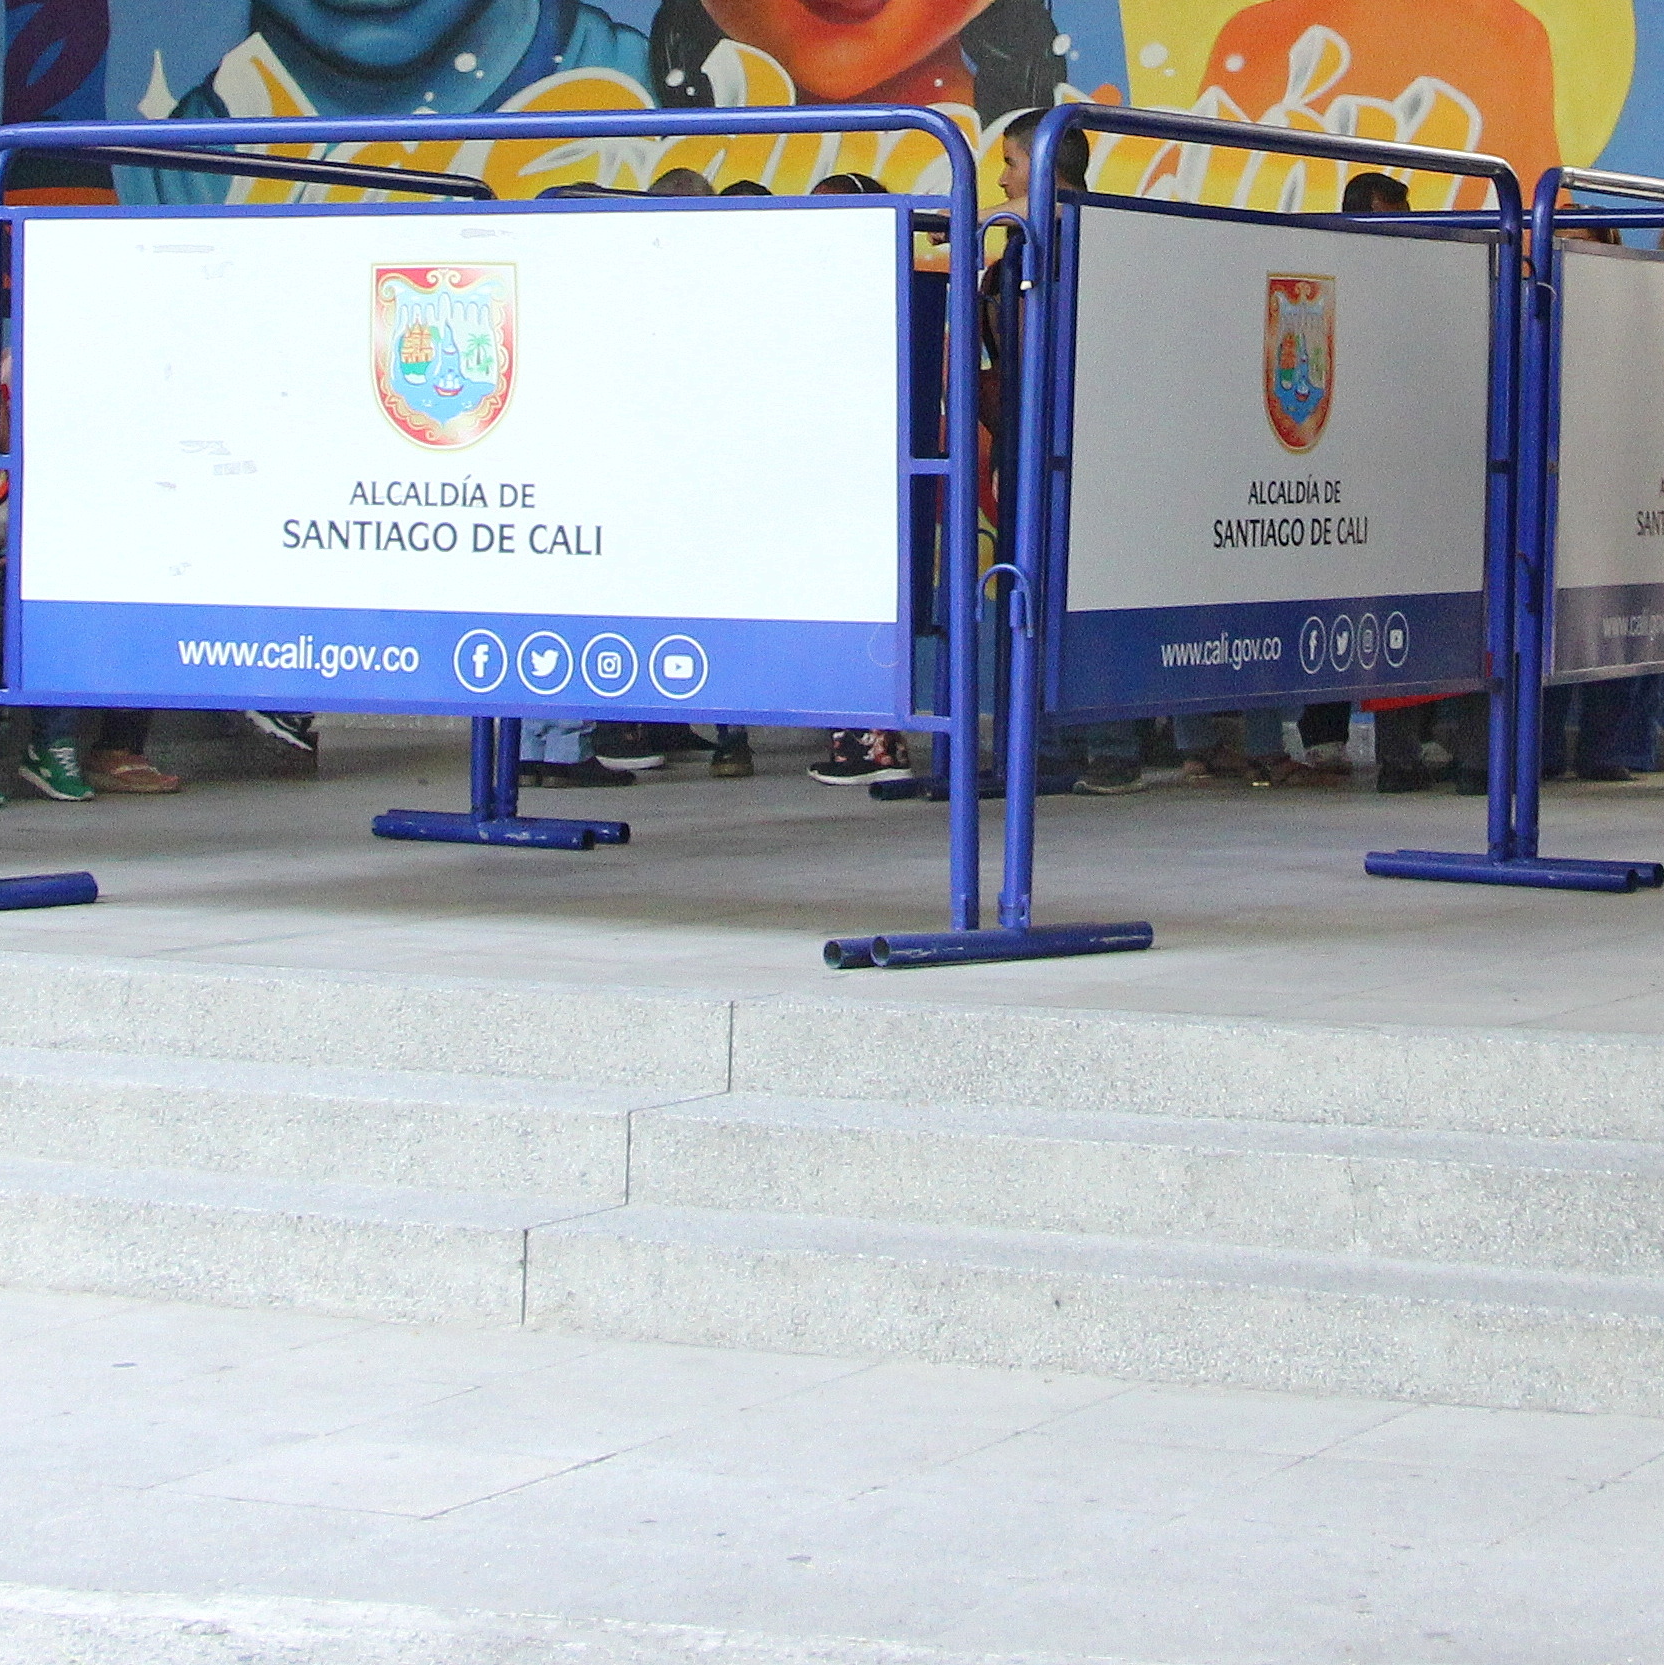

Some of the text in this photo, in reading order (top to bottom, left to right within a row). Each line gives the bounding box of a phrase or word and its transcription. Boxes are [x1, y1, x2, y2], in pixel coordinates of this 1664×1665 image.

[349, 474, 536, 509] ALCALDÍA DE
[1248, 474, 1341, 505] ALCALDÍA DE
[281, 519, 603, 556] SANTIAGO DE CALI
[1213, 516, 1368, 549] SANTIAGO DE CALI
[178, 636, 420, 677] www.cali.gov.co
[1161, 631, 1281, 671] www.cali.gov.co
